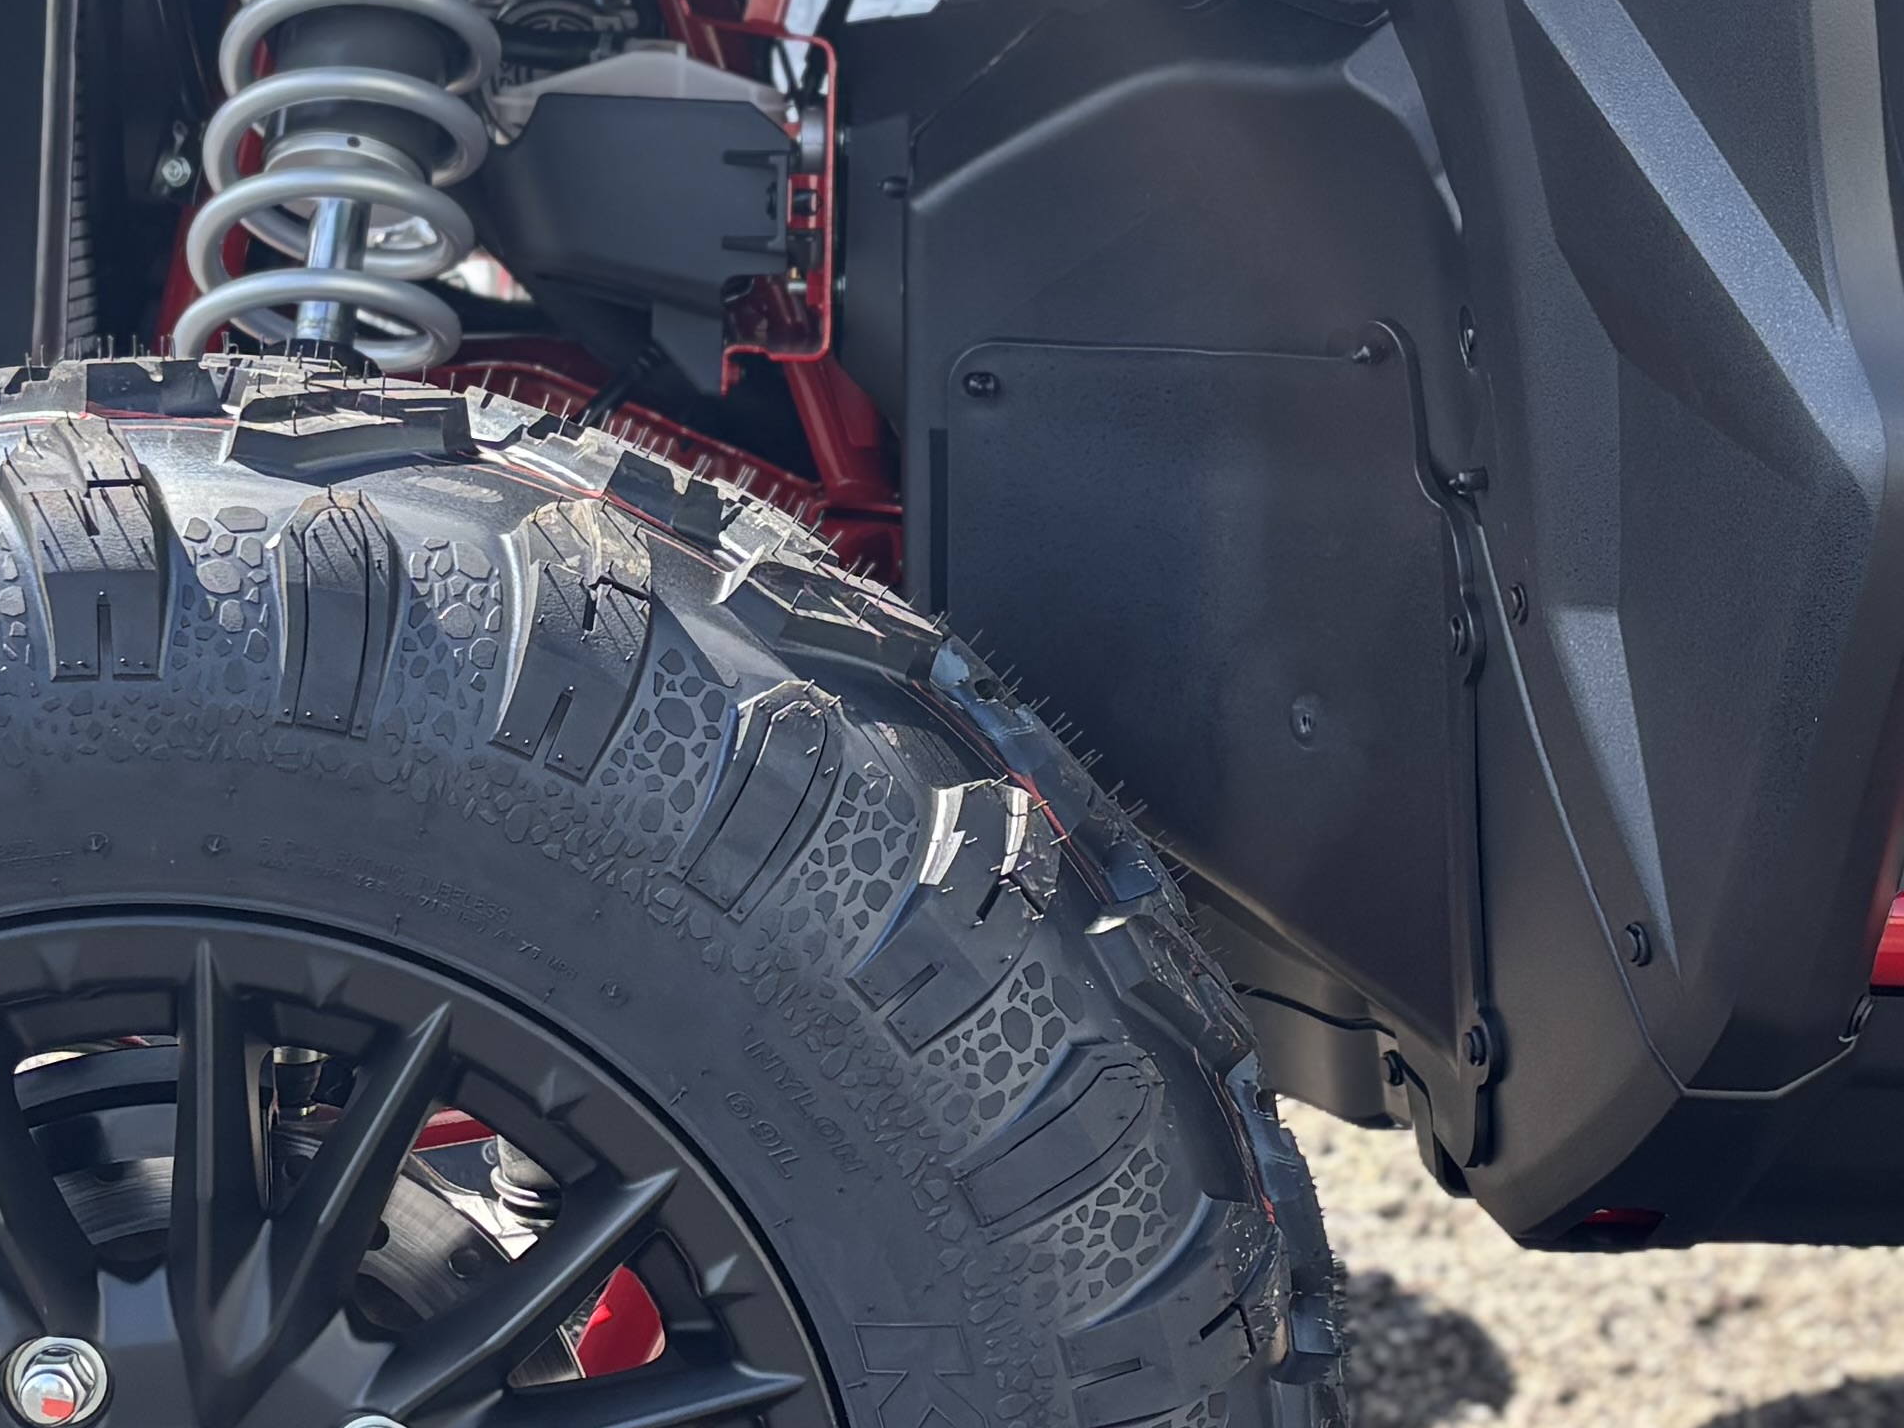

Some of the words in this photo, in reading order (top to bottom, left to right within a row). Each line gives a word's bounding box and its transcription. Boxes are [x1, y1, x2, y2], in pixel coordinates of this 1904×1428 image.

[414, 871, 515, 927] TUBELESS
[725, 1090, 800, 1180] 69L
[744, 1038, 868, 1173] NYLON
